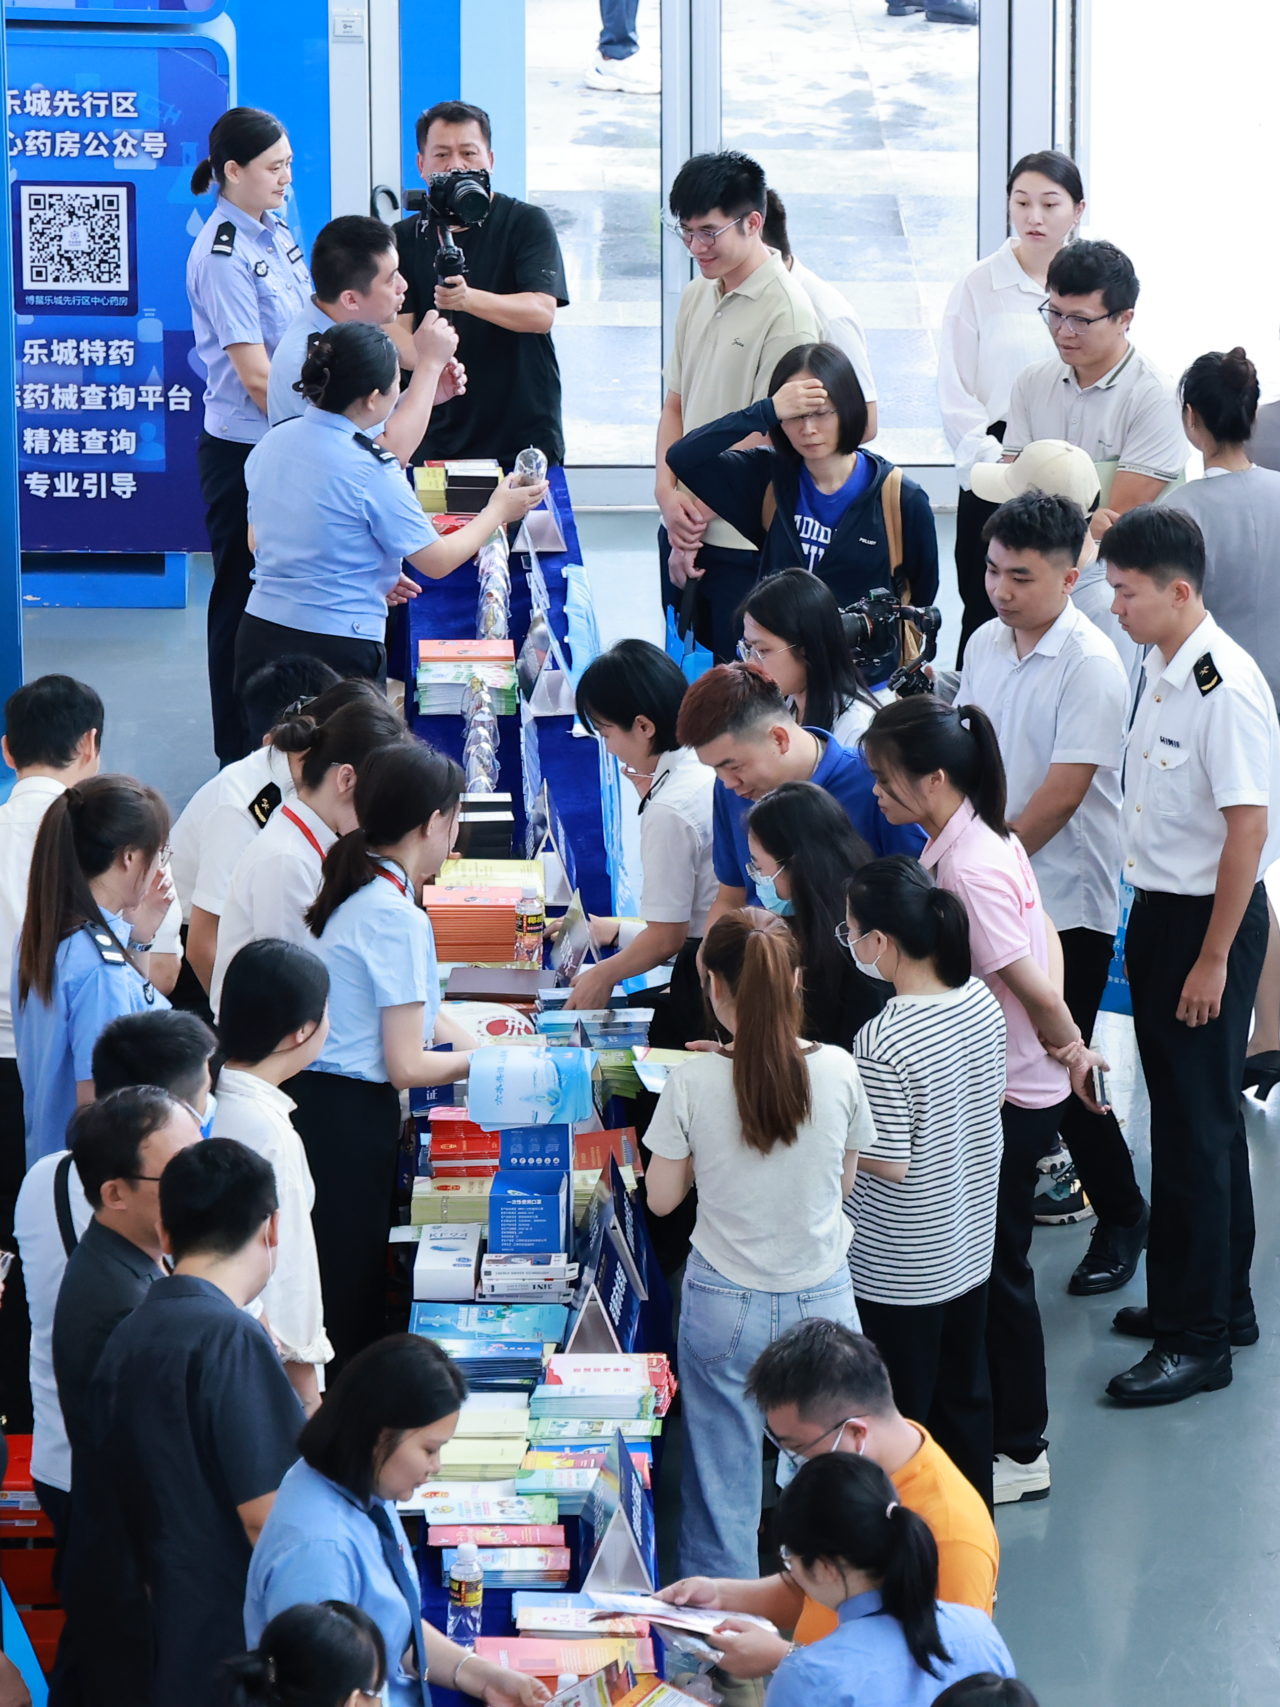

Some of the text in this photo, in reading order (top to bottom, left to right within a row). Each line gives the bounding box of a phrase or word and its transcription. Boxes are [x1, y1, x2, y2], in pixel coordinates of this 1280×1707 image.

[22, 339, 135, 366] 乐城特药
[16, 384, 192, 412] 药械查询平台
[23, 428, 137, 455] 精准查询
[24, 472, 137, 499] 专业引导
